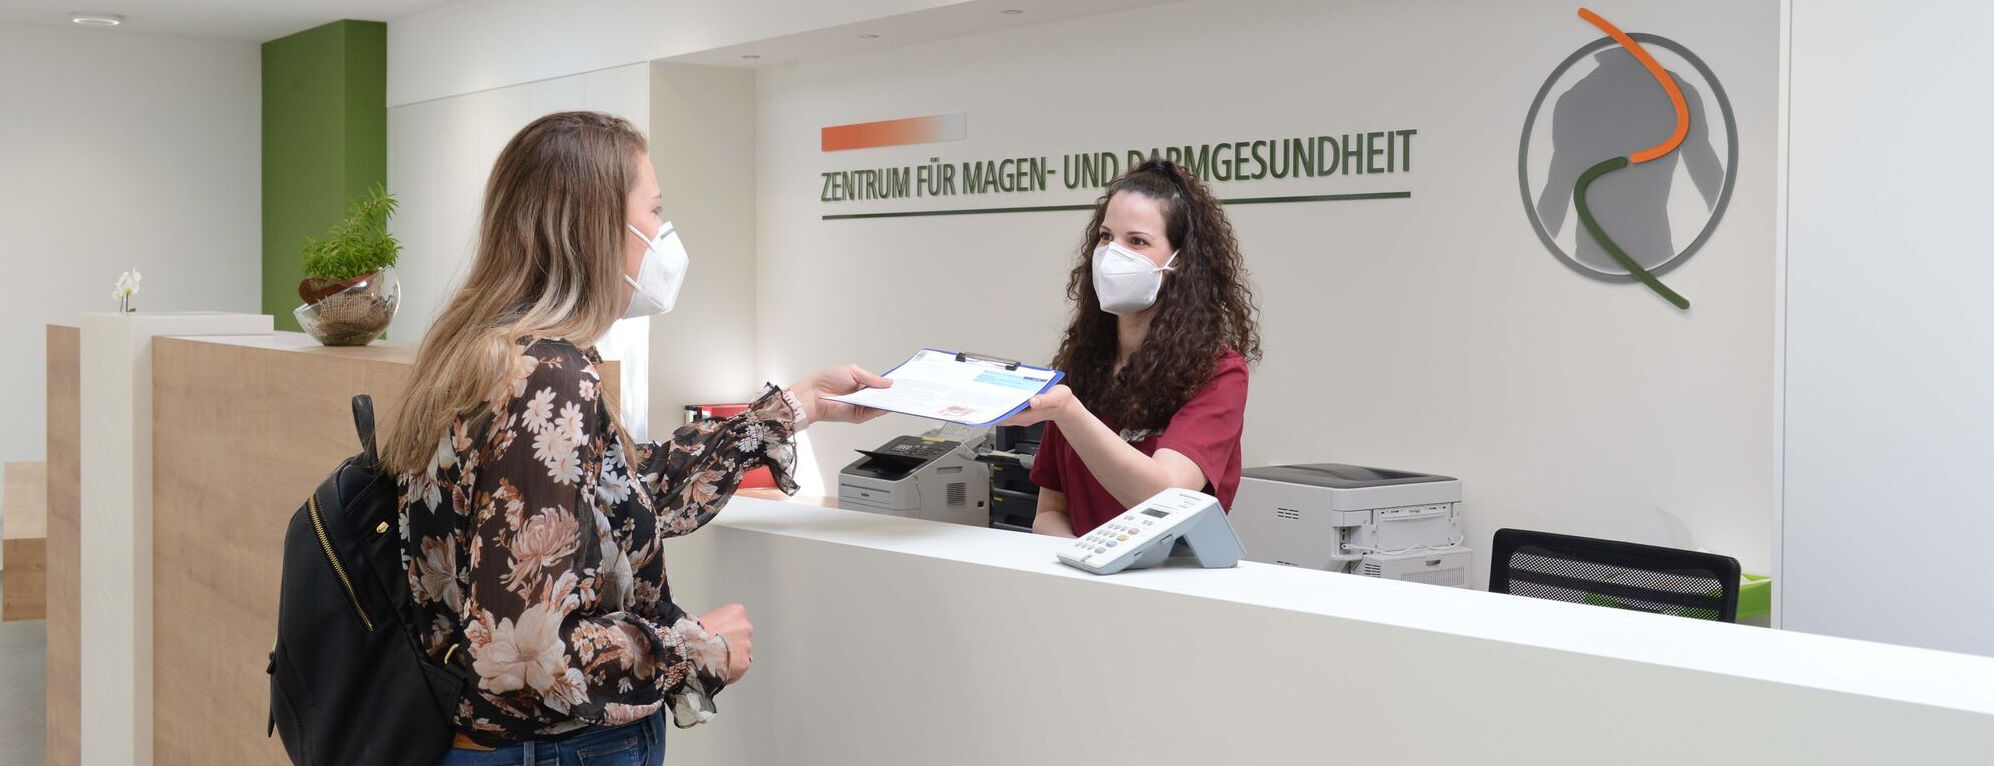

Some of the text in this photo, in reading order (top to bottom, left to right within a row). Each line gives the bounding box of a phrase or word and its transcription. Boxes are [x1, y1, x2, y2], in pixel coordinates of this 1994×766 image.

[820, 166, 911, 202] ZENTRUM
[916, 157, 957, 198] FÜR
[962, 156, 1056, 195] MAGEN-
[1063, 152, 1119, 190] UND
